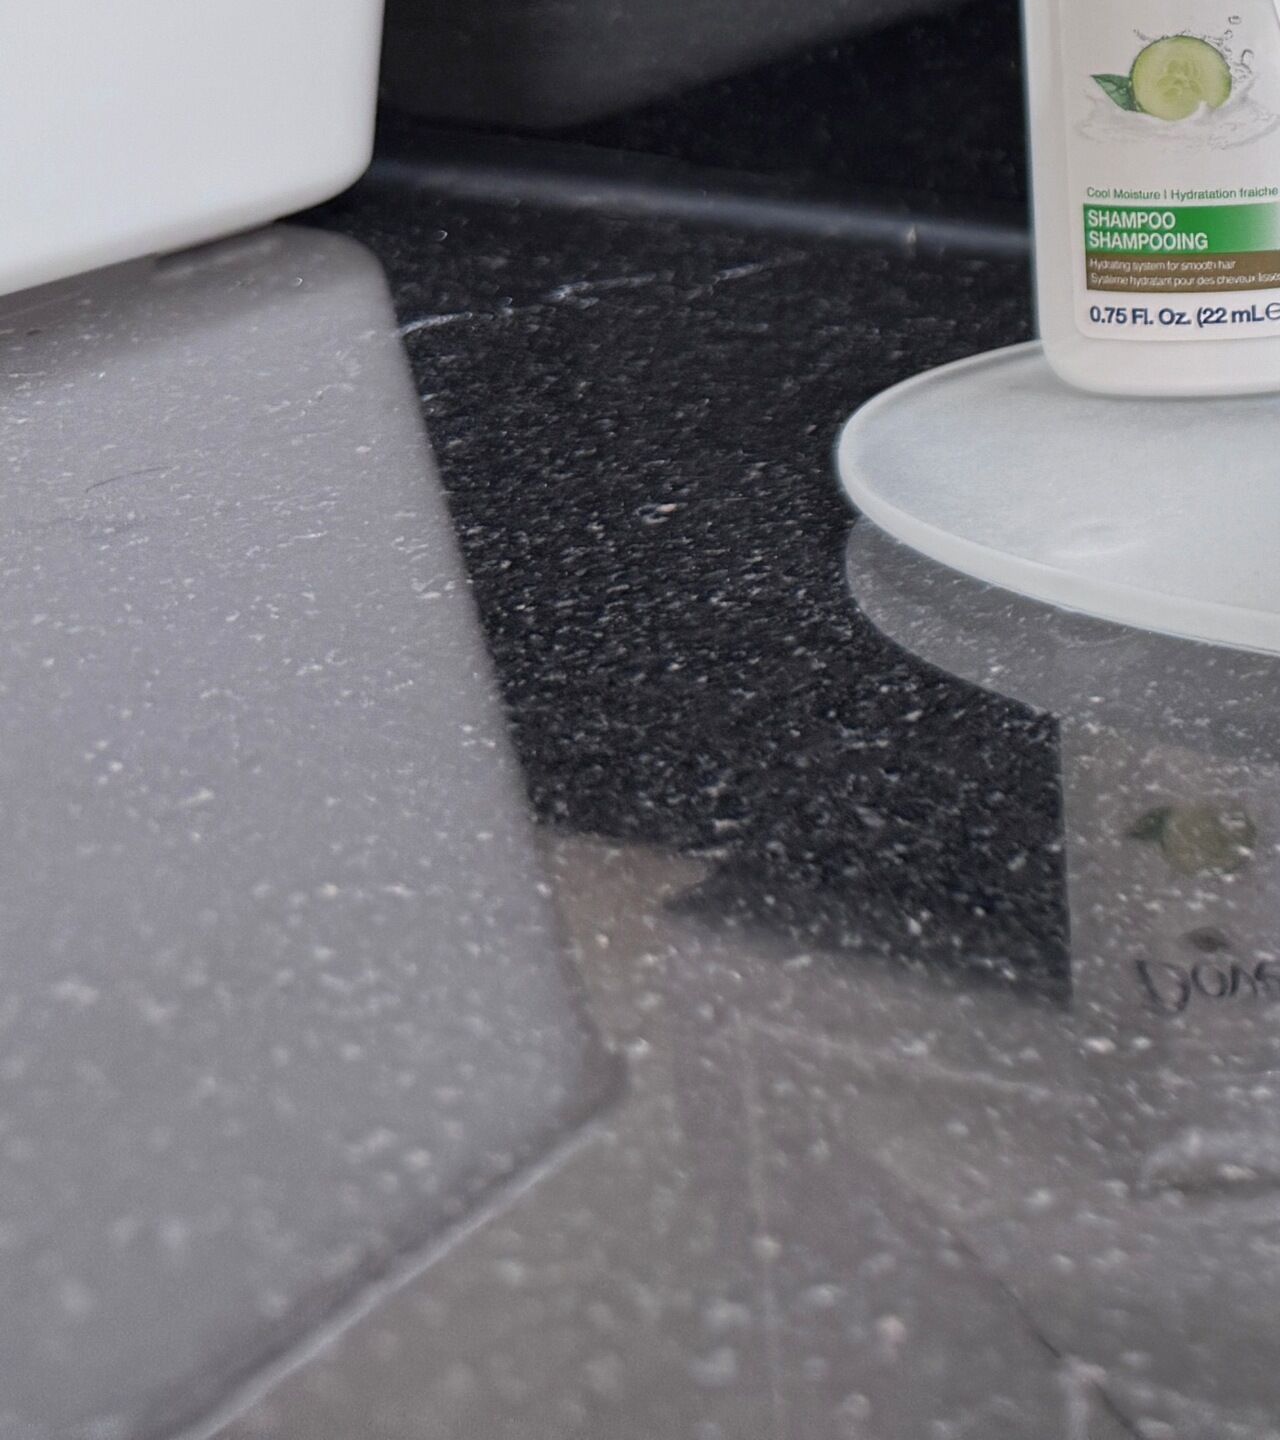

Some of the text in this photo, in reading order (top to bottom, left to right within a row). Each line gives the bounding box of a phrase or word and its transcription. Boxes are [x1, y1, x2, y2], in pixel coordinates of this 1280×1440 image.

[1086, 186, 1111, 198] Cool
[1113, 188, 1161, 200] Moisture
[1171, 188, 1236, 201] Hydratation
[1087, 210, 1176, 230] SHAMPOO
[1088, 230, 1208, 251] SHAMPOOING
[1090, 258, 1236, 272] Hydrating system for smooth hair
[1130, 275, 1172, 288] hydratant
[1174, 277, 1195, 288] pour
[1198, 274, 1216, 285] des
[1217, 273, 1256, 284] cheveux
[1089, 305, 1128, 324] 0.75
[1132, 308, 1154, 325] Fl.
[1158, 308, 1192, 326] Oz.
[1196, 306, 1228, 328] (22
